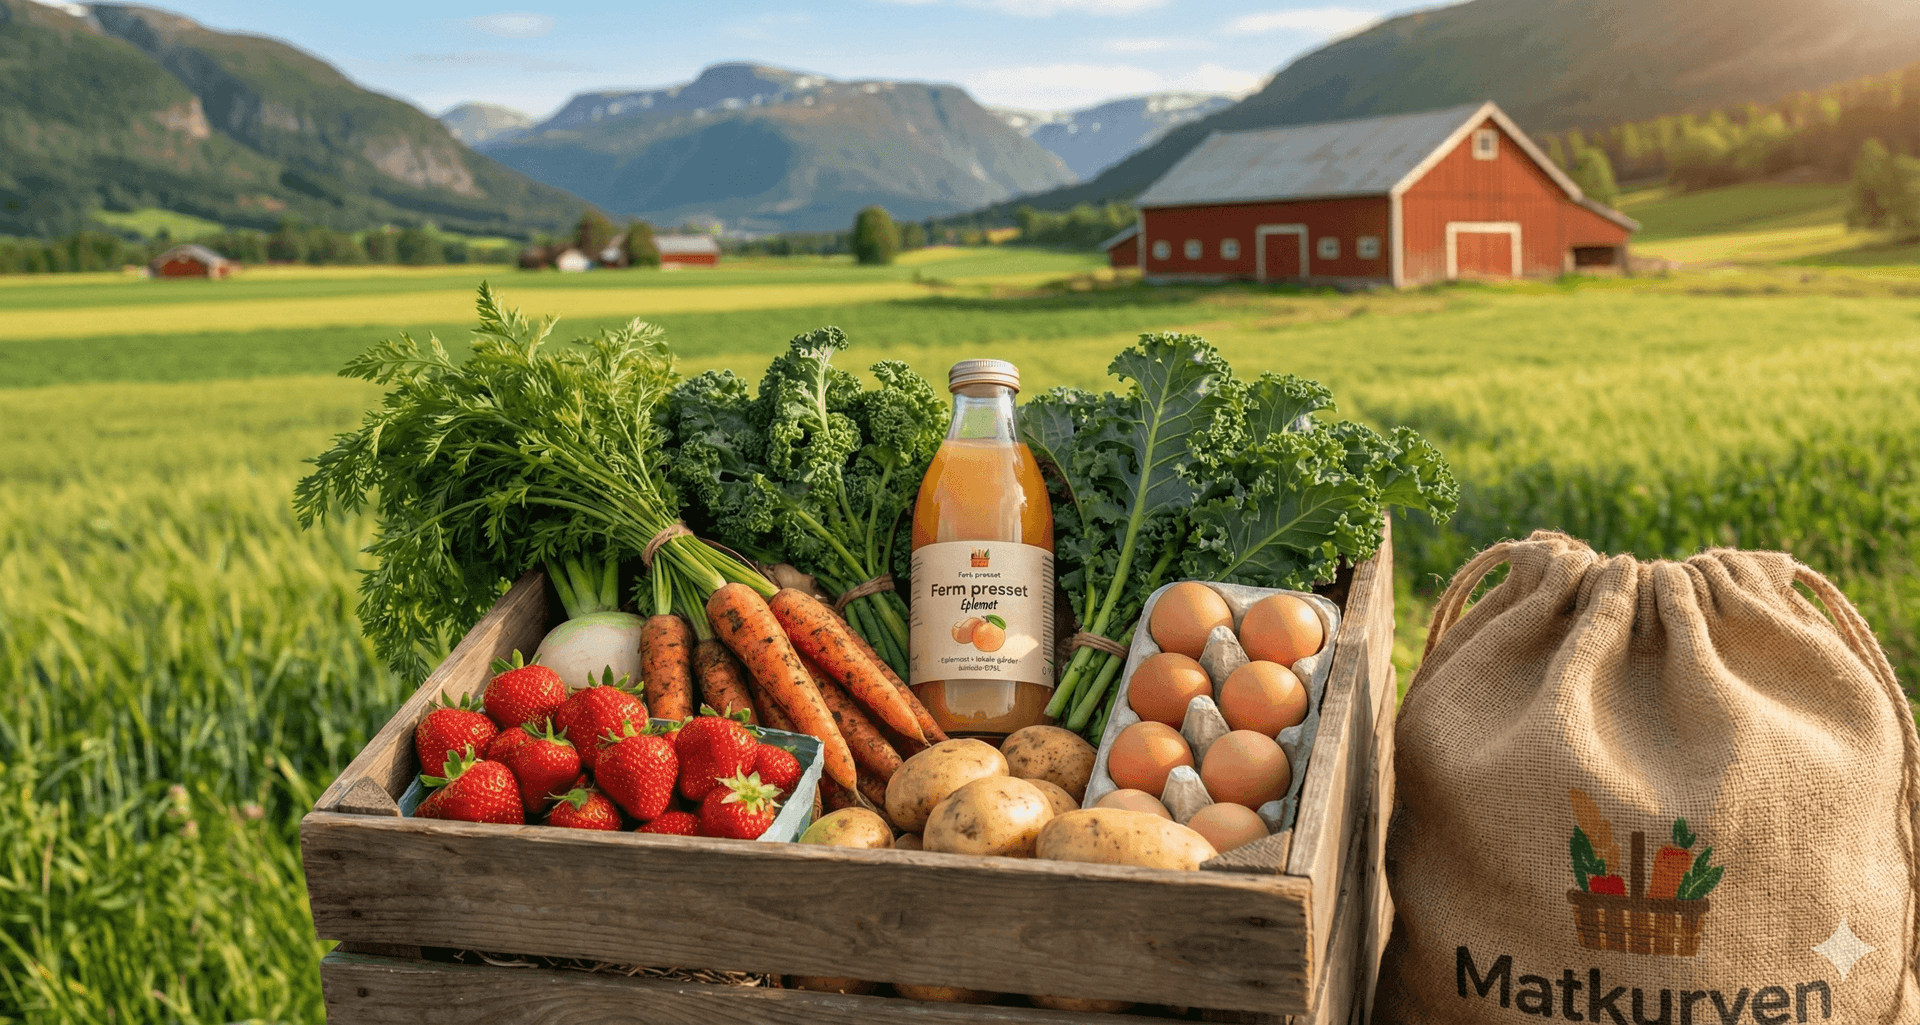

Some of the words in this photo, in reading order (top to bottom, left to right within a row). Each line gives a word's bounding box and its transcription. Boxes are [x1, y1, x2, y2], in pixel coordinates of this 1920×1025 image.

[931, 584, 966, 597] Ferm
[971, 584, 1028, 598] presset
[975, 655, 996, 663] lokale
[1456, 945, 1832, 1025] Matkurven
